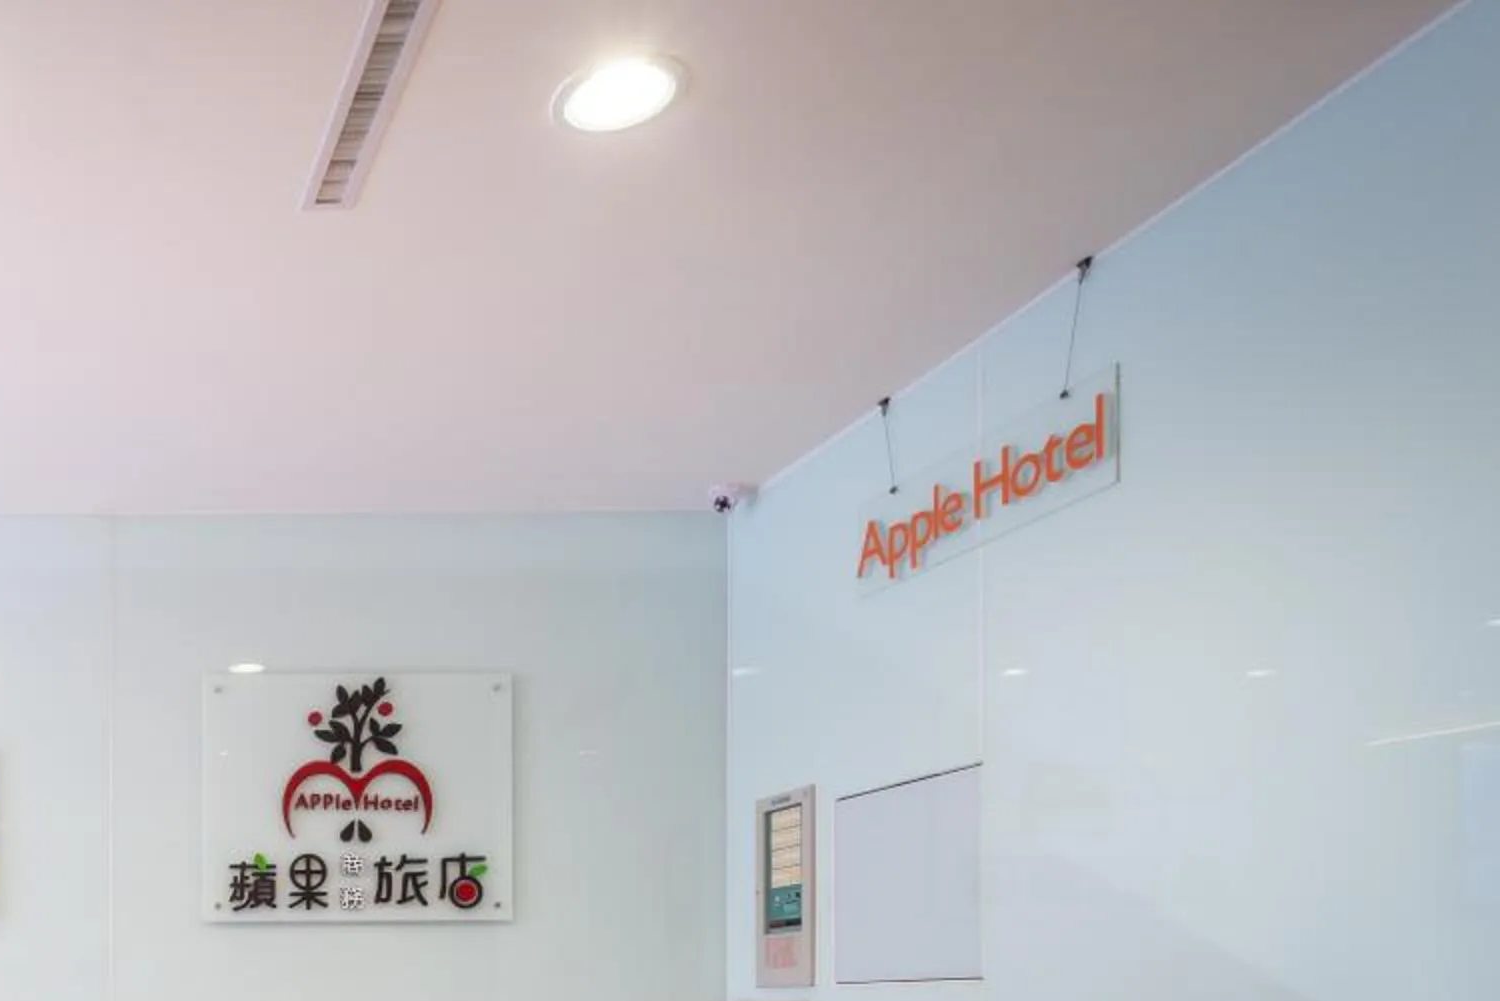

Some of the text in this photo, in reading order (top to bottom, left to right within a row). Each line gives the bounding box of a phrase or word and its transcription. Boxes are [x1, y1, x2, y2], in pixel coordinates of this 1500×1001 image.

[856, 393, 1105, 579] Apple Hotel
[363, 793, 419, 812] Hotel
